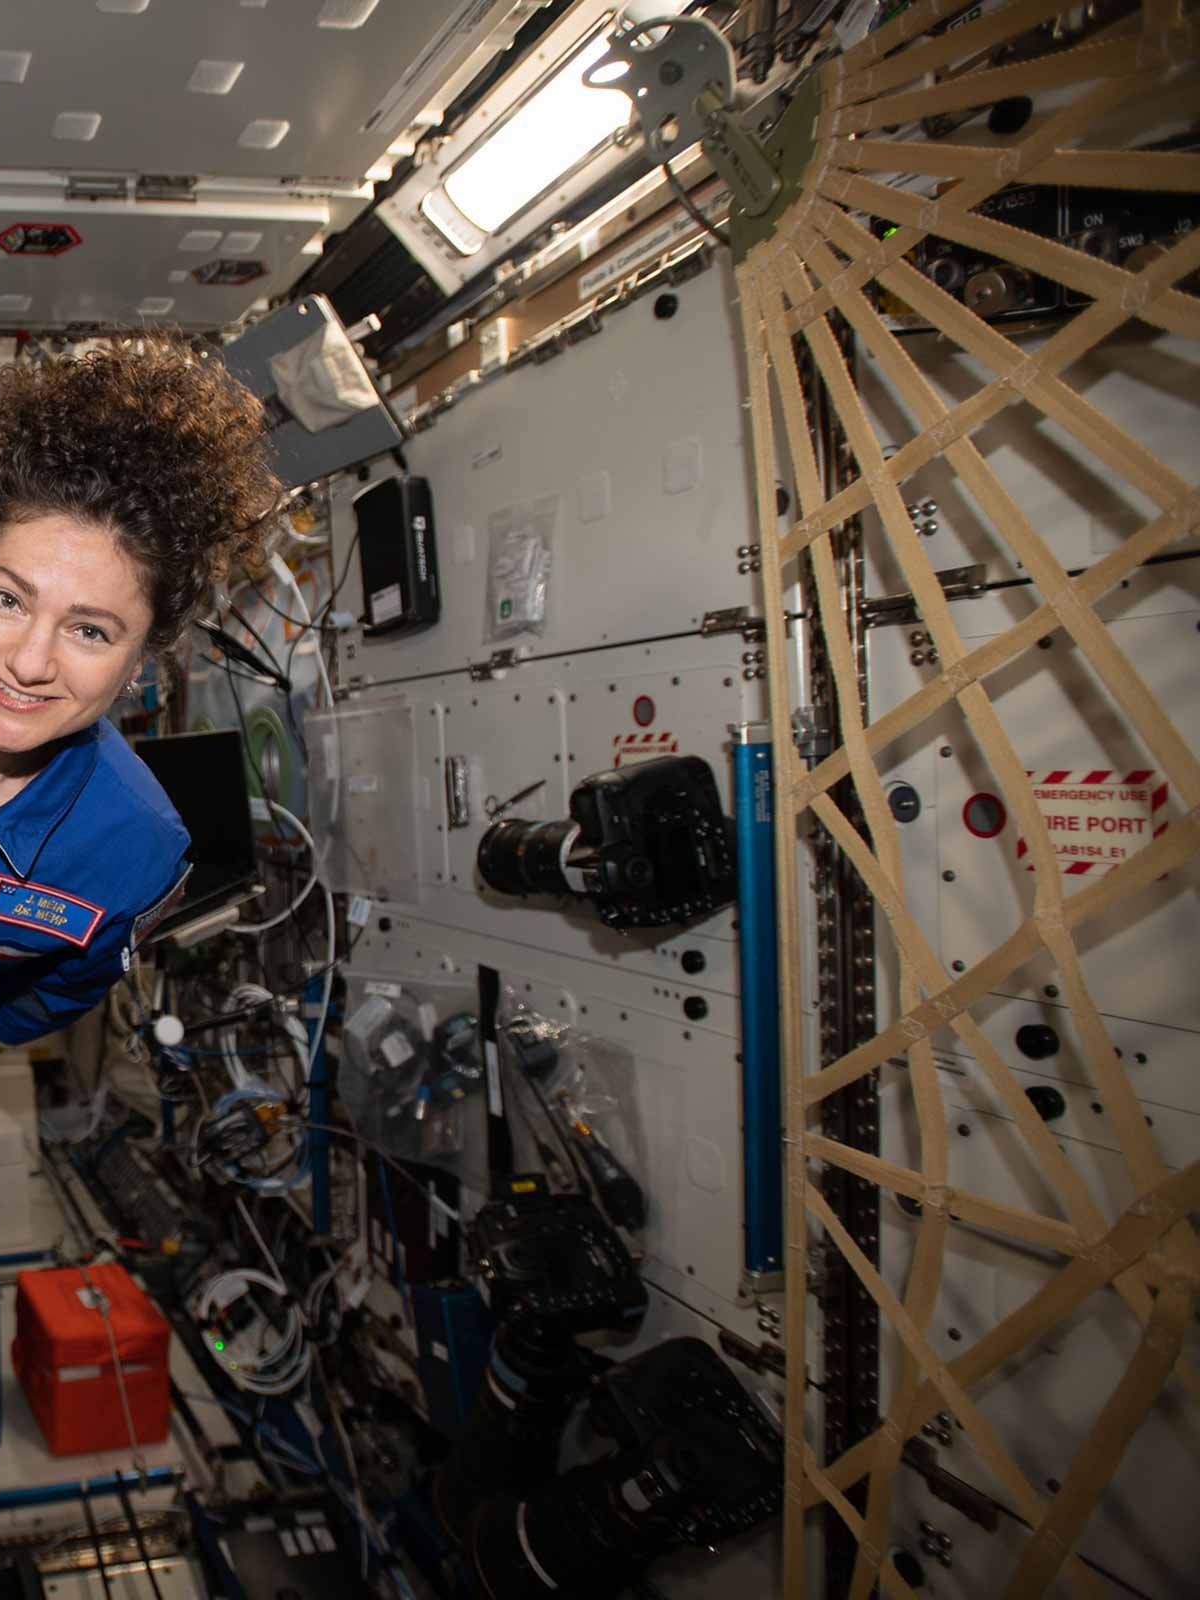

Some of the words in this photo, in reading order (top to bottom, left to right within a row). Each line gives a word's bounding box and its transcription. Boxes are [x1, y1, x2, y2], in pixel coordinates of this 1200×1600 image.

[1084, 213, 1103, 227] ON
[1033, 789, 1114, 801] EMERGENCY
[1119, 791, 1149, 801] USE
[1044, 815, 1080, 832] IRE
[1085, 817, 1146, 834] PORT
[37, 897, 66, 914] MEIR
